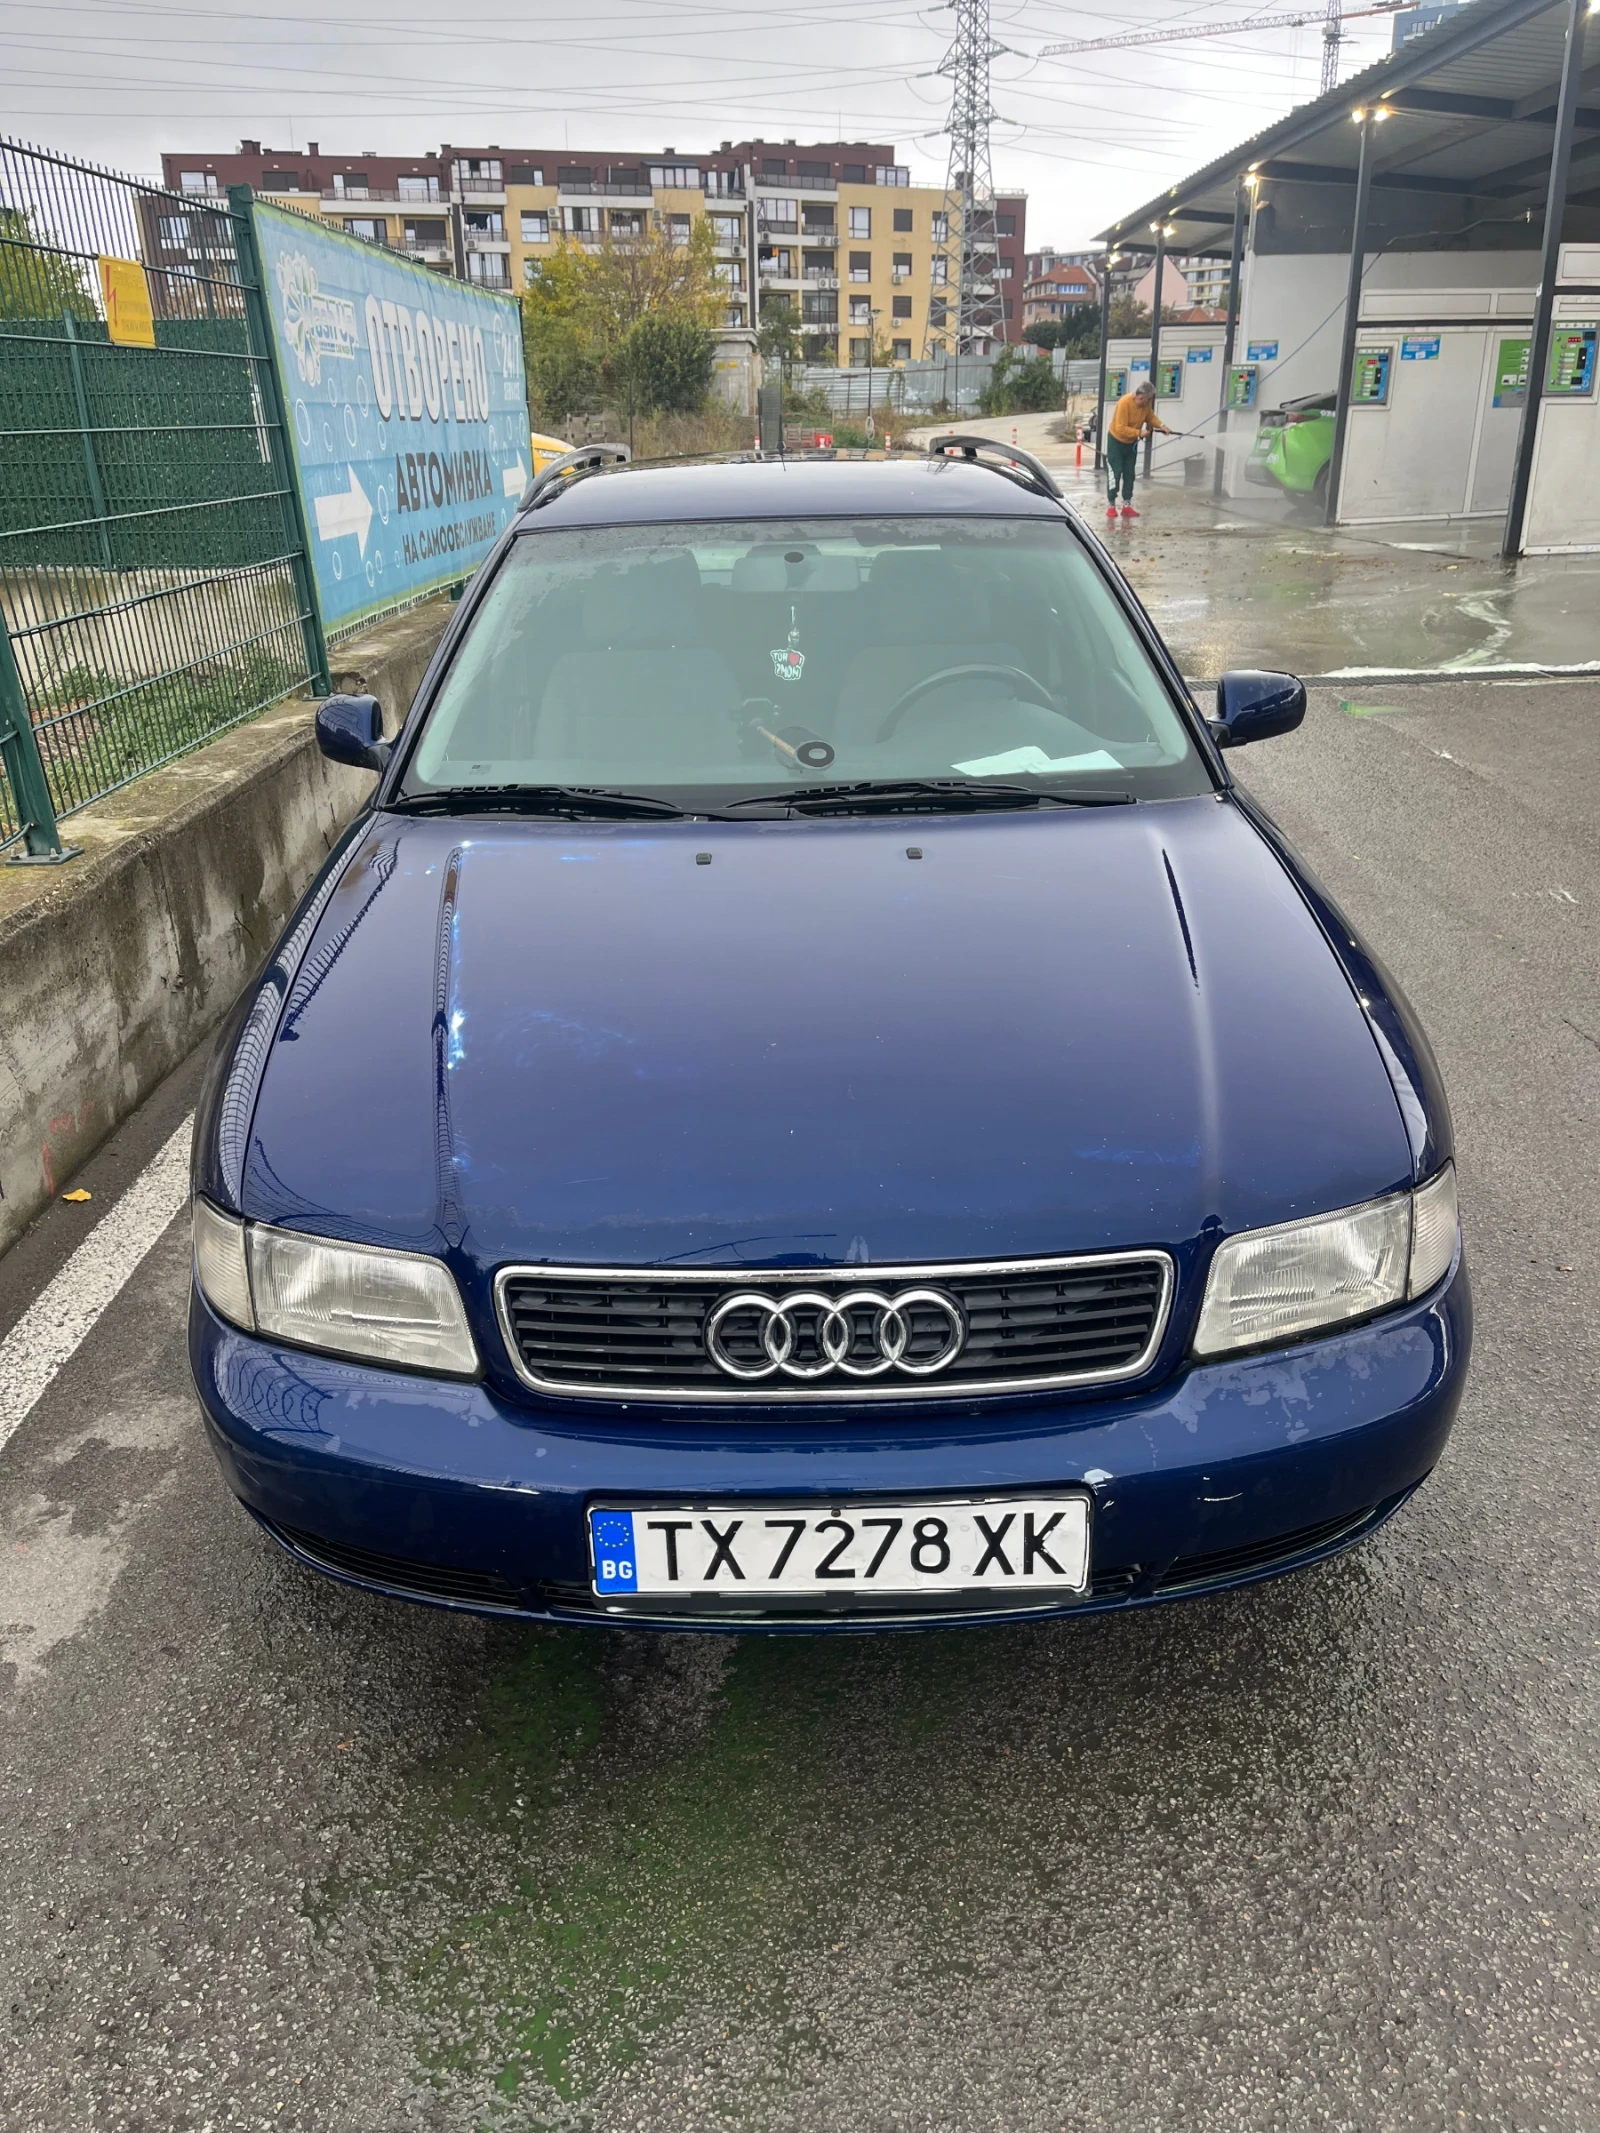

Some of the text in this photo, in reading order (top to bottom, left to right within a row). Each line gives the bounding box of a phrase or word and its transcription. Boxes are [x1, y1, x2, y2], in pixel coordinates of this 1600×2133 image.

[365, 294, 489, 424] ОТВОРЕНО
[395, 448, 493, 514] АВТОМИВКА
[402, 512, 496, 565] НА САМООБСЛУЖВАНЕ
[601, 1559, 633, 1579] BG
[647, 1511, 1068, 1581] TX 7278 XK
